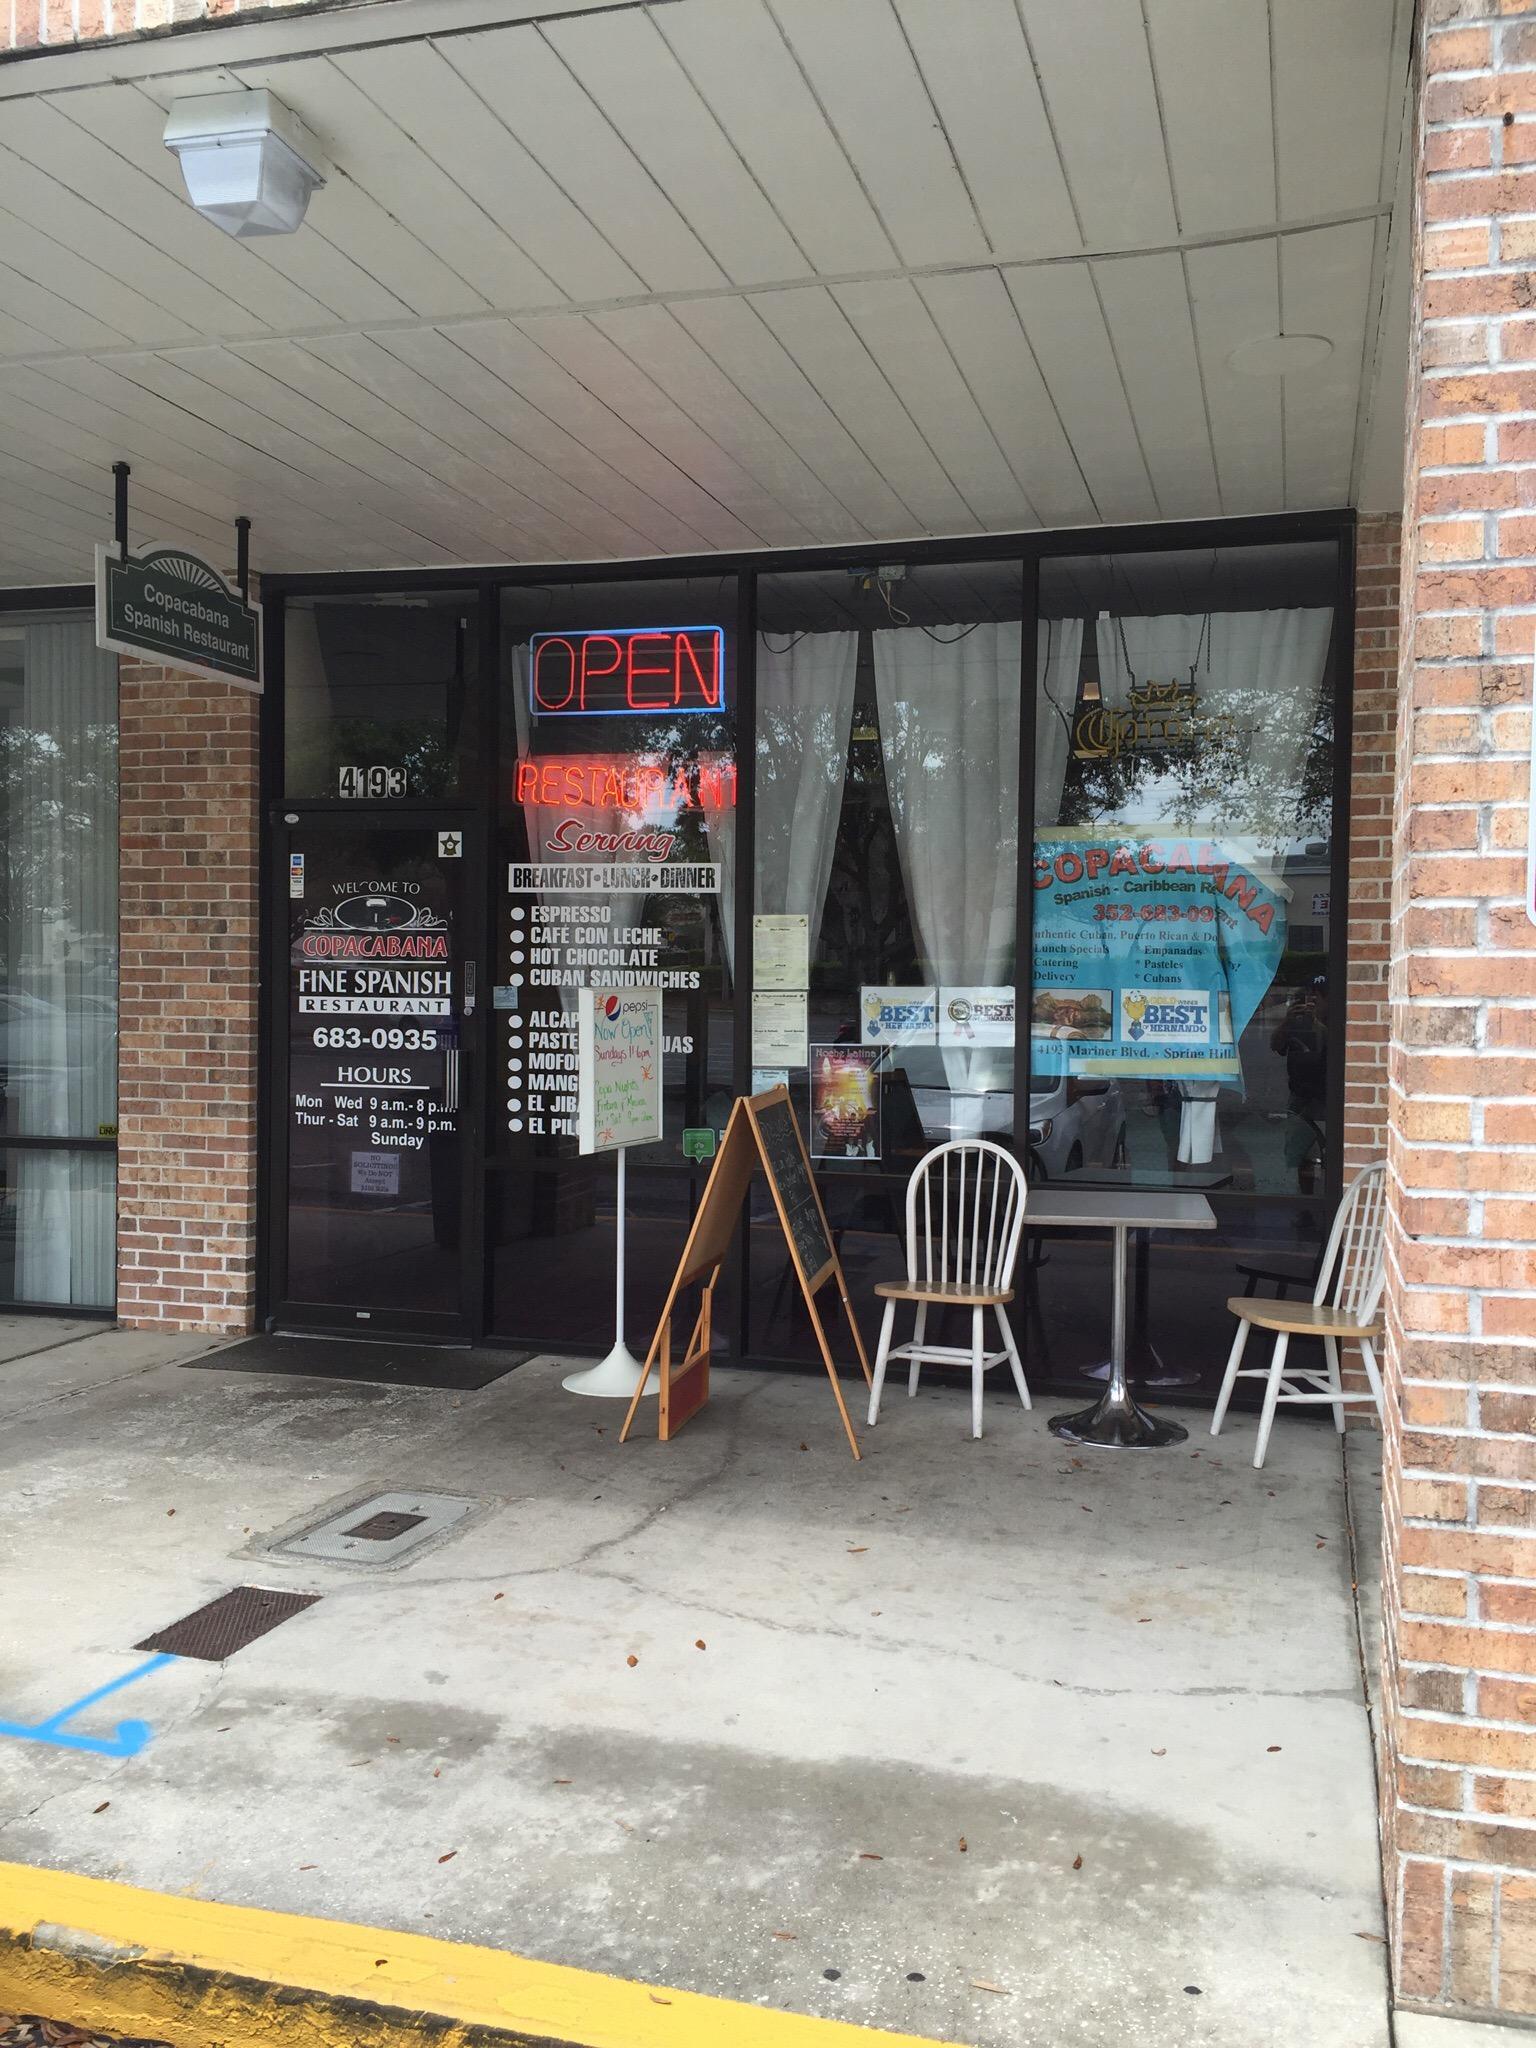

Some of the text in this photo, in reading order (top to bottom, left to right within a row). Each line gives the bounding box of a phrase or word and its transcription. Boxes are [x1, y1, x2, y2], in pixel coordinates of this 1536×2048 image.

[144, 583, 230, 629] Copacabana
[124, 603, 250, 660] Spanish Restaurant
[535, 631, 720, 710] OPEN
[339, 766, 407, 798] 4193
[517, 762, 737, 809] RESTAURANT
[546, 817, 677, 862] Serving
[513, 867, 716, 888] BREAKFAST LUNCH DINNER
[402, 881, 420, 895] TO
[1054, 884, 1110, 905] Spanish
[1123, 880, 1196, 894] Caribbean
[530, 906, 611, 923] ESPRESSO
[530, 925, 662, 945] CAFÉ CON LECHE
[1120, 931, 1156, 941] Puerto
[1159, 931, 1188, 941] Rican
[1191, 932, 1200, 941] &
[302, 935, 449, 957] COPACABANA
[1034, 944, 1110, 955] Lunch Specials
[1144, 947, 1202, 956] Empanadas
[529, 948, 658, 967] HOT CHOCOLATE
[1034, 957, 1079, 970] Catering
[1144, 960, 1184, 969] Pasteles
[300, 970, 347, 993] FINE
[354, 970, 451, 995] SPANISH
[530, 969, 700, 989] CUBAN SANDWICHES
[1034, 971, 1075, 982] Delivery
[1143, 973, 1182, 984] Cubans
[305, 999, 445, 1013] RESTAURANT
[622, 1000, 648, 1015] pepsi
[879, 1005, 934, 1021] BEST
[974, 1004, 1014, 1016] BEST
[1143, 1005, 1207, 1024] BEST
[594, 1022, 618, 1041] Now
[1150, 1025, 1207, 1033] HERNANDO
[312, 1027, 437, 1050] 683-0935
[594, 1045, 627, 1062] Sundays
[816, 1048, 877, 1058] Noche Latina
[1038, 1045, 1063, 1054] 4193
[1068, 1045, 1117, 1056] Mariner
[1121, 1047, 1150, 1057] Blvd.
[1164, 1049, 1204, 1059] Spring
[338, 1067, 411, 1083] HOURS
[295, 1095, 323, 1108] Mon
[334, 1096, 363, 1110] Wed
[370, 1097, 377, 1110] 9
[417, 1099, 424, 1111] 8
[528, 1095, 545, 1111] EL
[295, 1112, 325, 1125] Thur
[337, 1113, 359, 1127] Sat
[369, 1115, 376, 1128] 9
[416, 1117, 424, 1130] 9
[428, 1120, 456, 1133] p.m.
[529, 1118, 546, 1134] EL
[371, 1132, 424, 1150] Sunday
